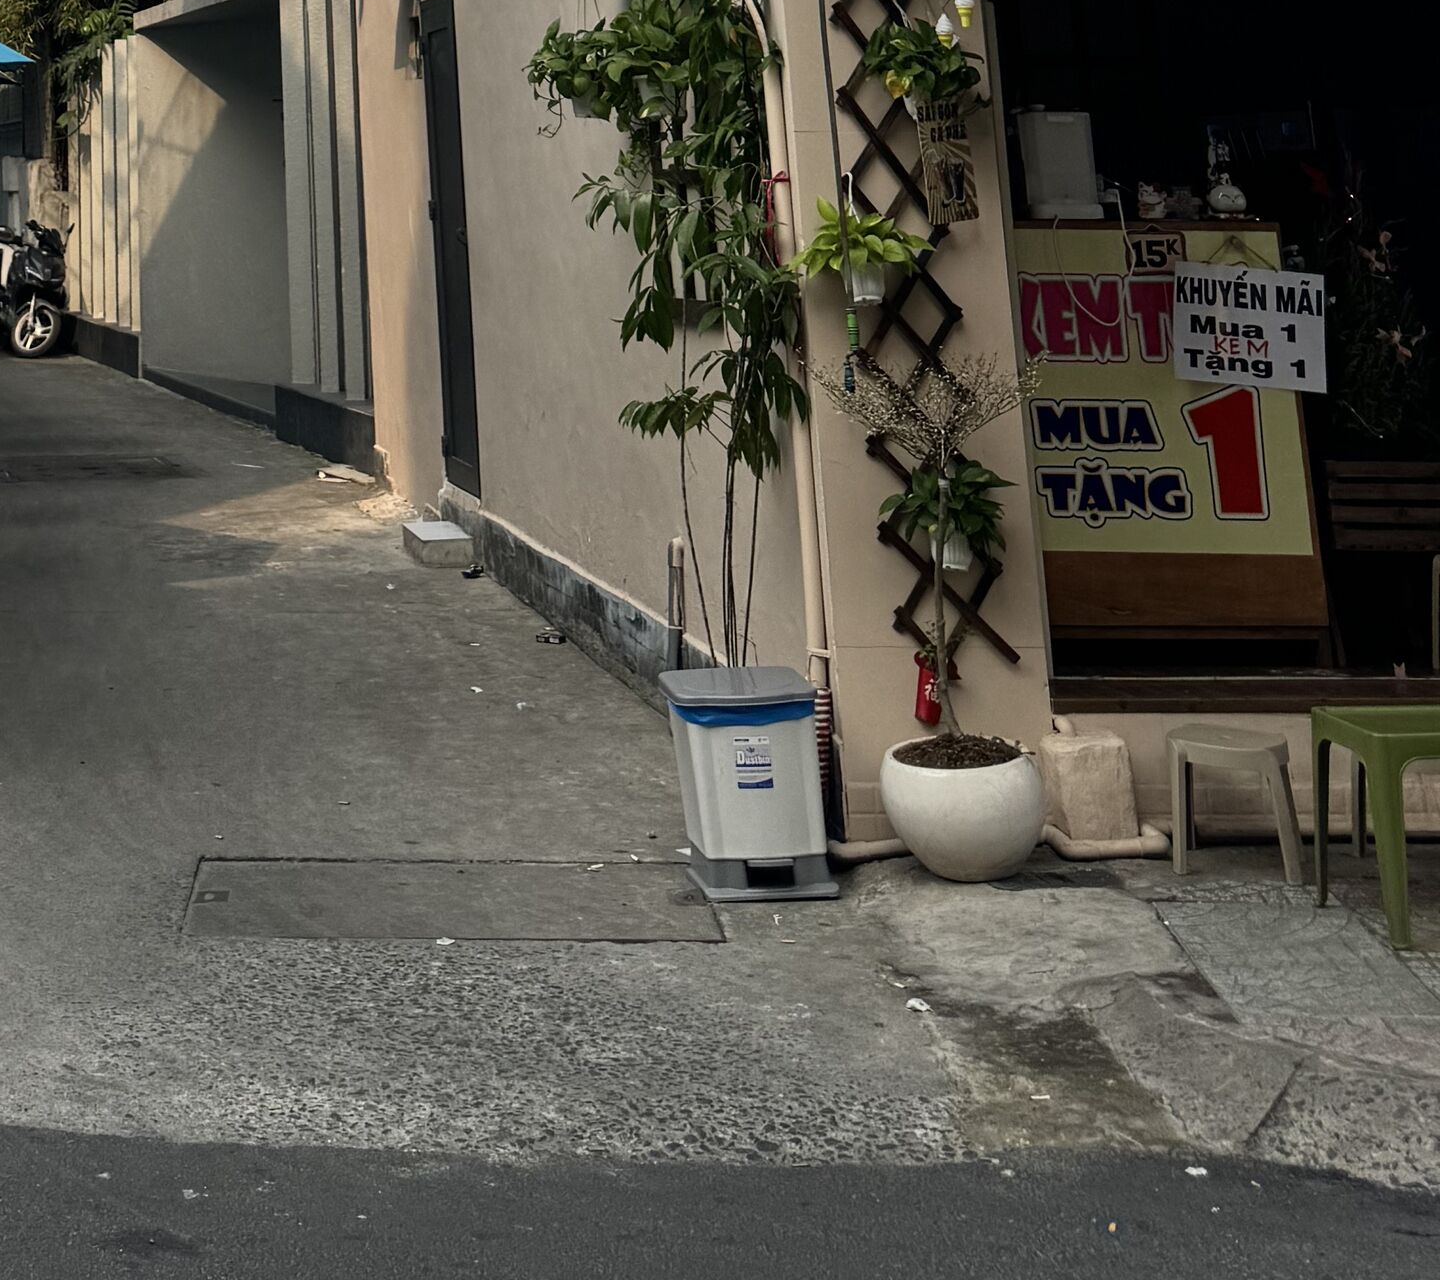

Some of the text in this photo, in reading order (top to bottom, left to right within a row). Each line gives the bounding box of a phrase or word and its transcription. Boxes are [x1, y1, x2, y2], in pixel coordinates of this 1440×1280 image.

[1132, 238, 1180, 268] 15K
[1176, 270, 1324, 317] KHUYẾN MÃI
[1189, 314, 1297, 343] Mua 1
[1183, 347, 1306, 379] Tặng 1
[1034, 405, 1161, 445] MUA
[1186, 387, 1267, 514] 1
[1040, 461, 1188, 522] TẶNG
